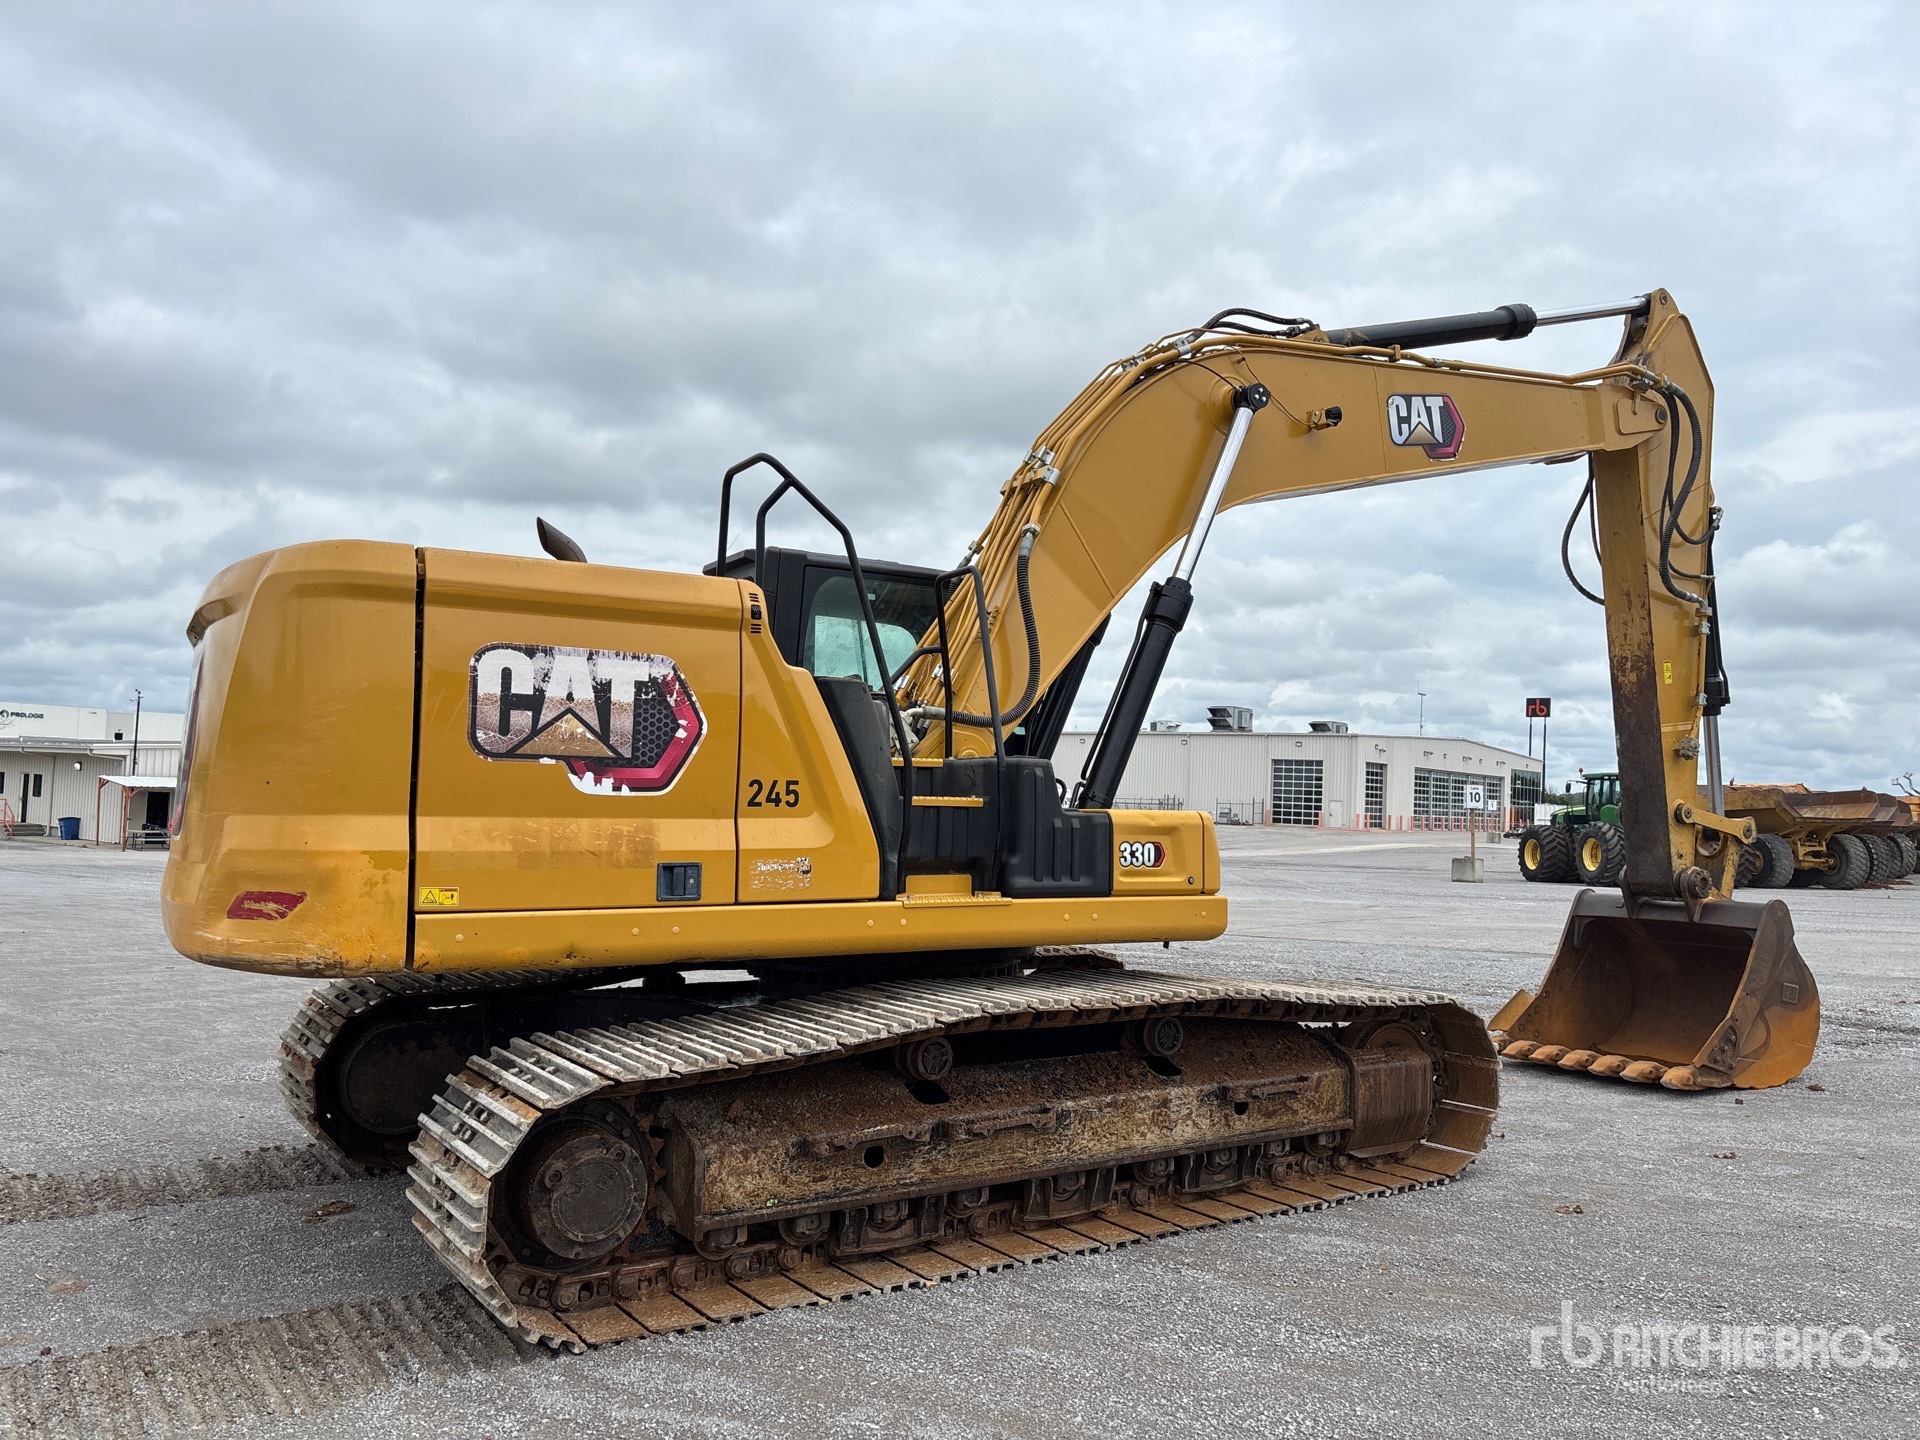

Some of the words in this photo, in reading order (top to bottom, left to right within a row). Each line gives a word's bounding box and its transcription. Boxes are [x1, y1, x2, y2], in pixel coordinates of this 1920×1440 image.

[1388, 395, 1444, 444] CAT
[10, 711, 44, 719] PROLOGIS
[475, 649, 650, 759] CAT
[1528, 699, 1547, 716] rb
[746, 778, 800, 808] 245
[1469, 791, 1481, 803] 10
[1119, 841, 1155, 867] 330
